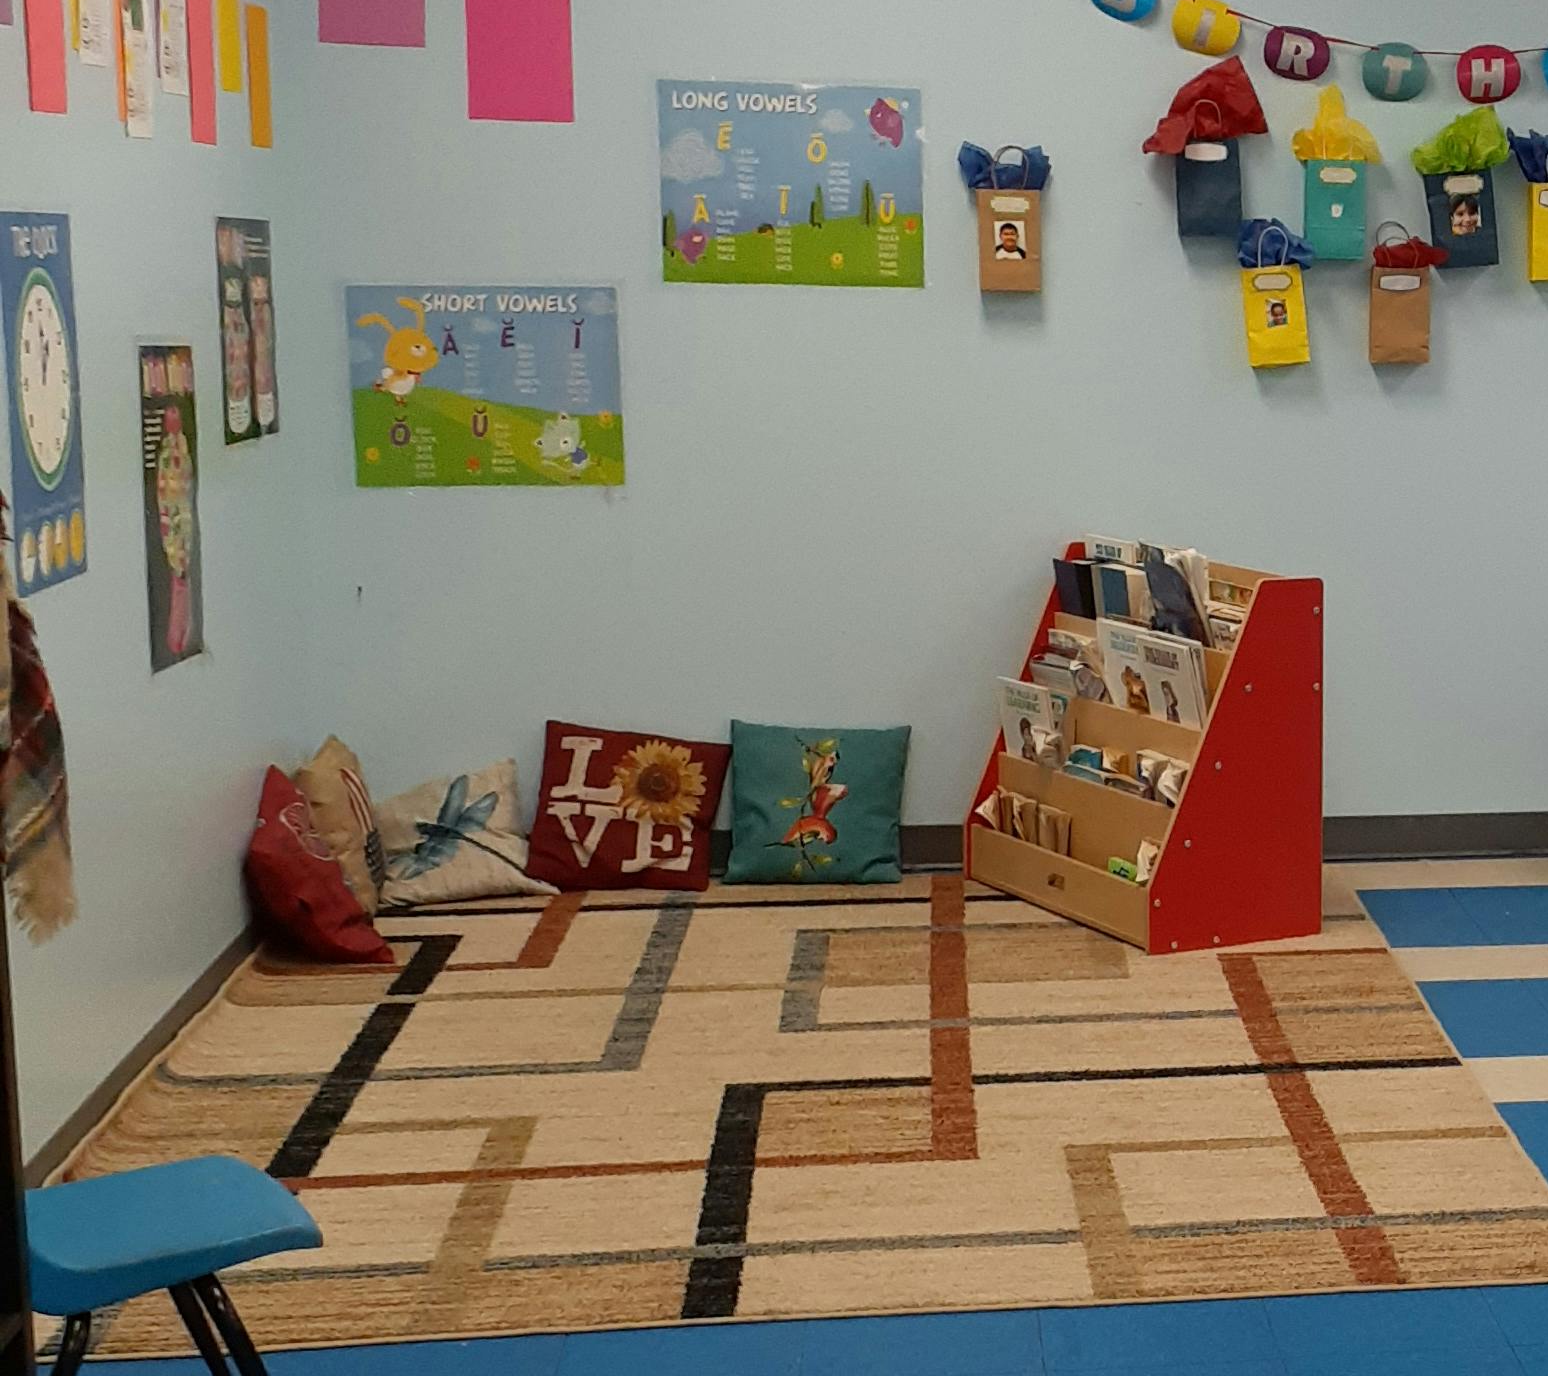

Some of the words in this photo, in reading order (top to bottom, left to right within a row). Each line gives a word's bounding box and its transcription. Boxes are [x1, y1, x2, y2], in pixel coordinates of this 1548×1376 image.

[671, 90, 729, 111] LONG
[736, 93, 817, 114] VOWELS
[421, 293, 486, 312] SHORT
[497, 294, 577, 314] VOWELS
